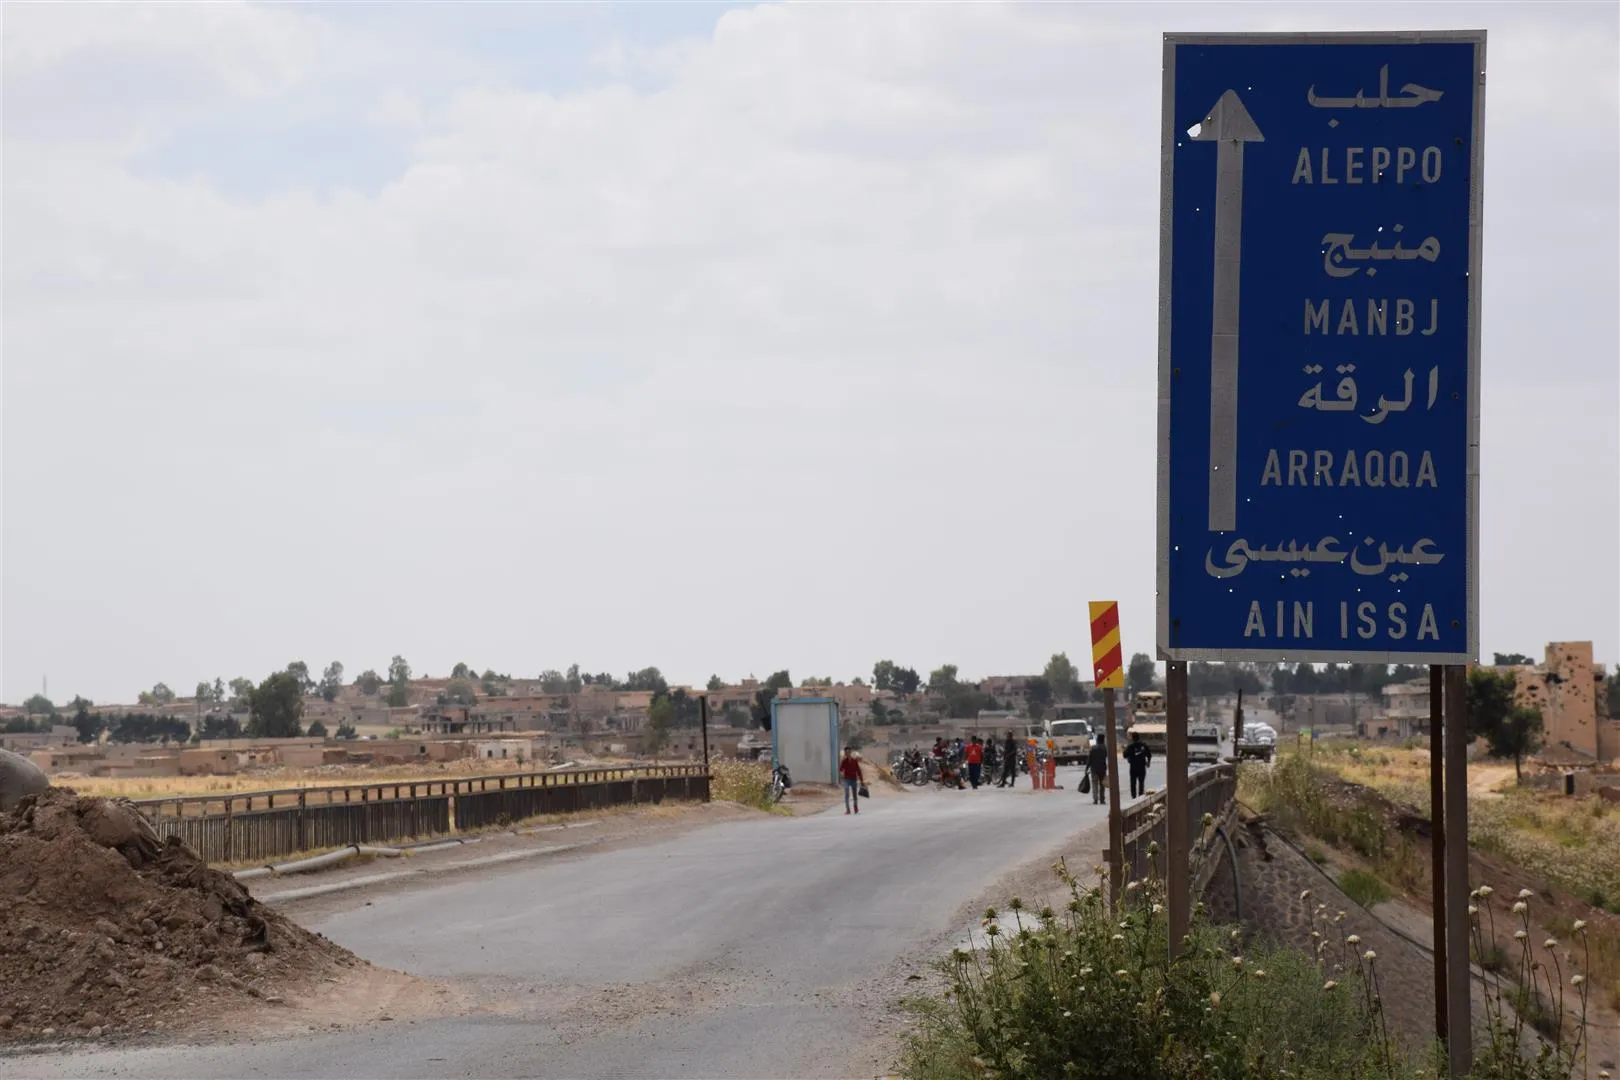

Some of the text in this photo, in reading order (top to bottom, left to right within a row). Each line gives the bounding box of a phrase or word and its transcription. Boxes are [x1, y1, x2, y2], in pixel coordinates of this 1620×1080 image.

[1307, 64, 1444, 128] حلب
[1292, 147, 1442, 184] ALEPPO
[1322, 224, 1441, 277] منبج
[1304, 298, 1438, 335] MANBJ
[1298, 364, 1439, 424] الرقة
[1261, 449, 1438, 488] ARRAQQA
[1205, 536, 1445, 583] عين عيسى
[1244, 601, 1440, 640] AIN ISSA
